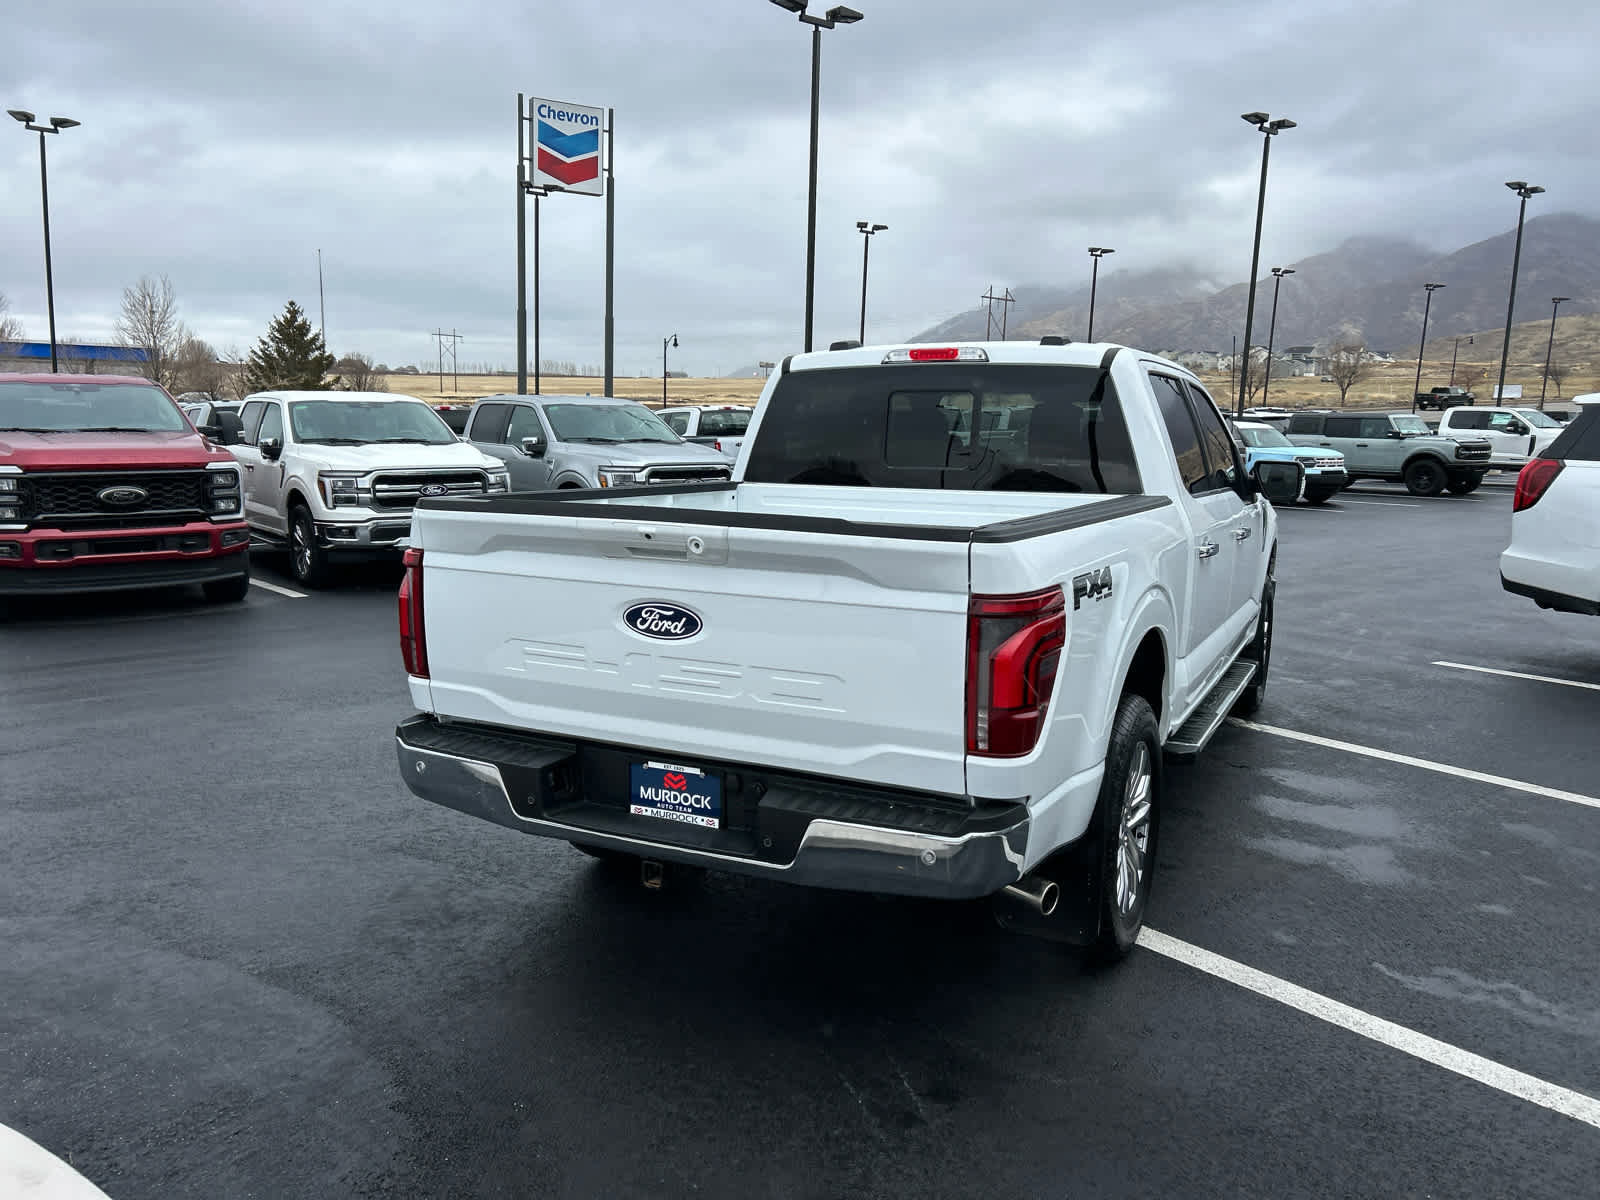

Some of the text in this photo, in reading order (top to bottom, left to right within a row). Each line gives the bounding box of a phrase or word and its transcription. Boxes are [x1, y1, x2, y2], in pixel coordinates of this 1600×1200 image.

[537, 104, 599, 126] Chevron
[1072, 566, 1112, 611] FX4
[636, 607, 687, 634] Ford
[640, 785, 712, 810] MURDOCK
[656, 802, 692, 813] AUTO TEAM
[650, 808, 698, 824] MURDOCK
